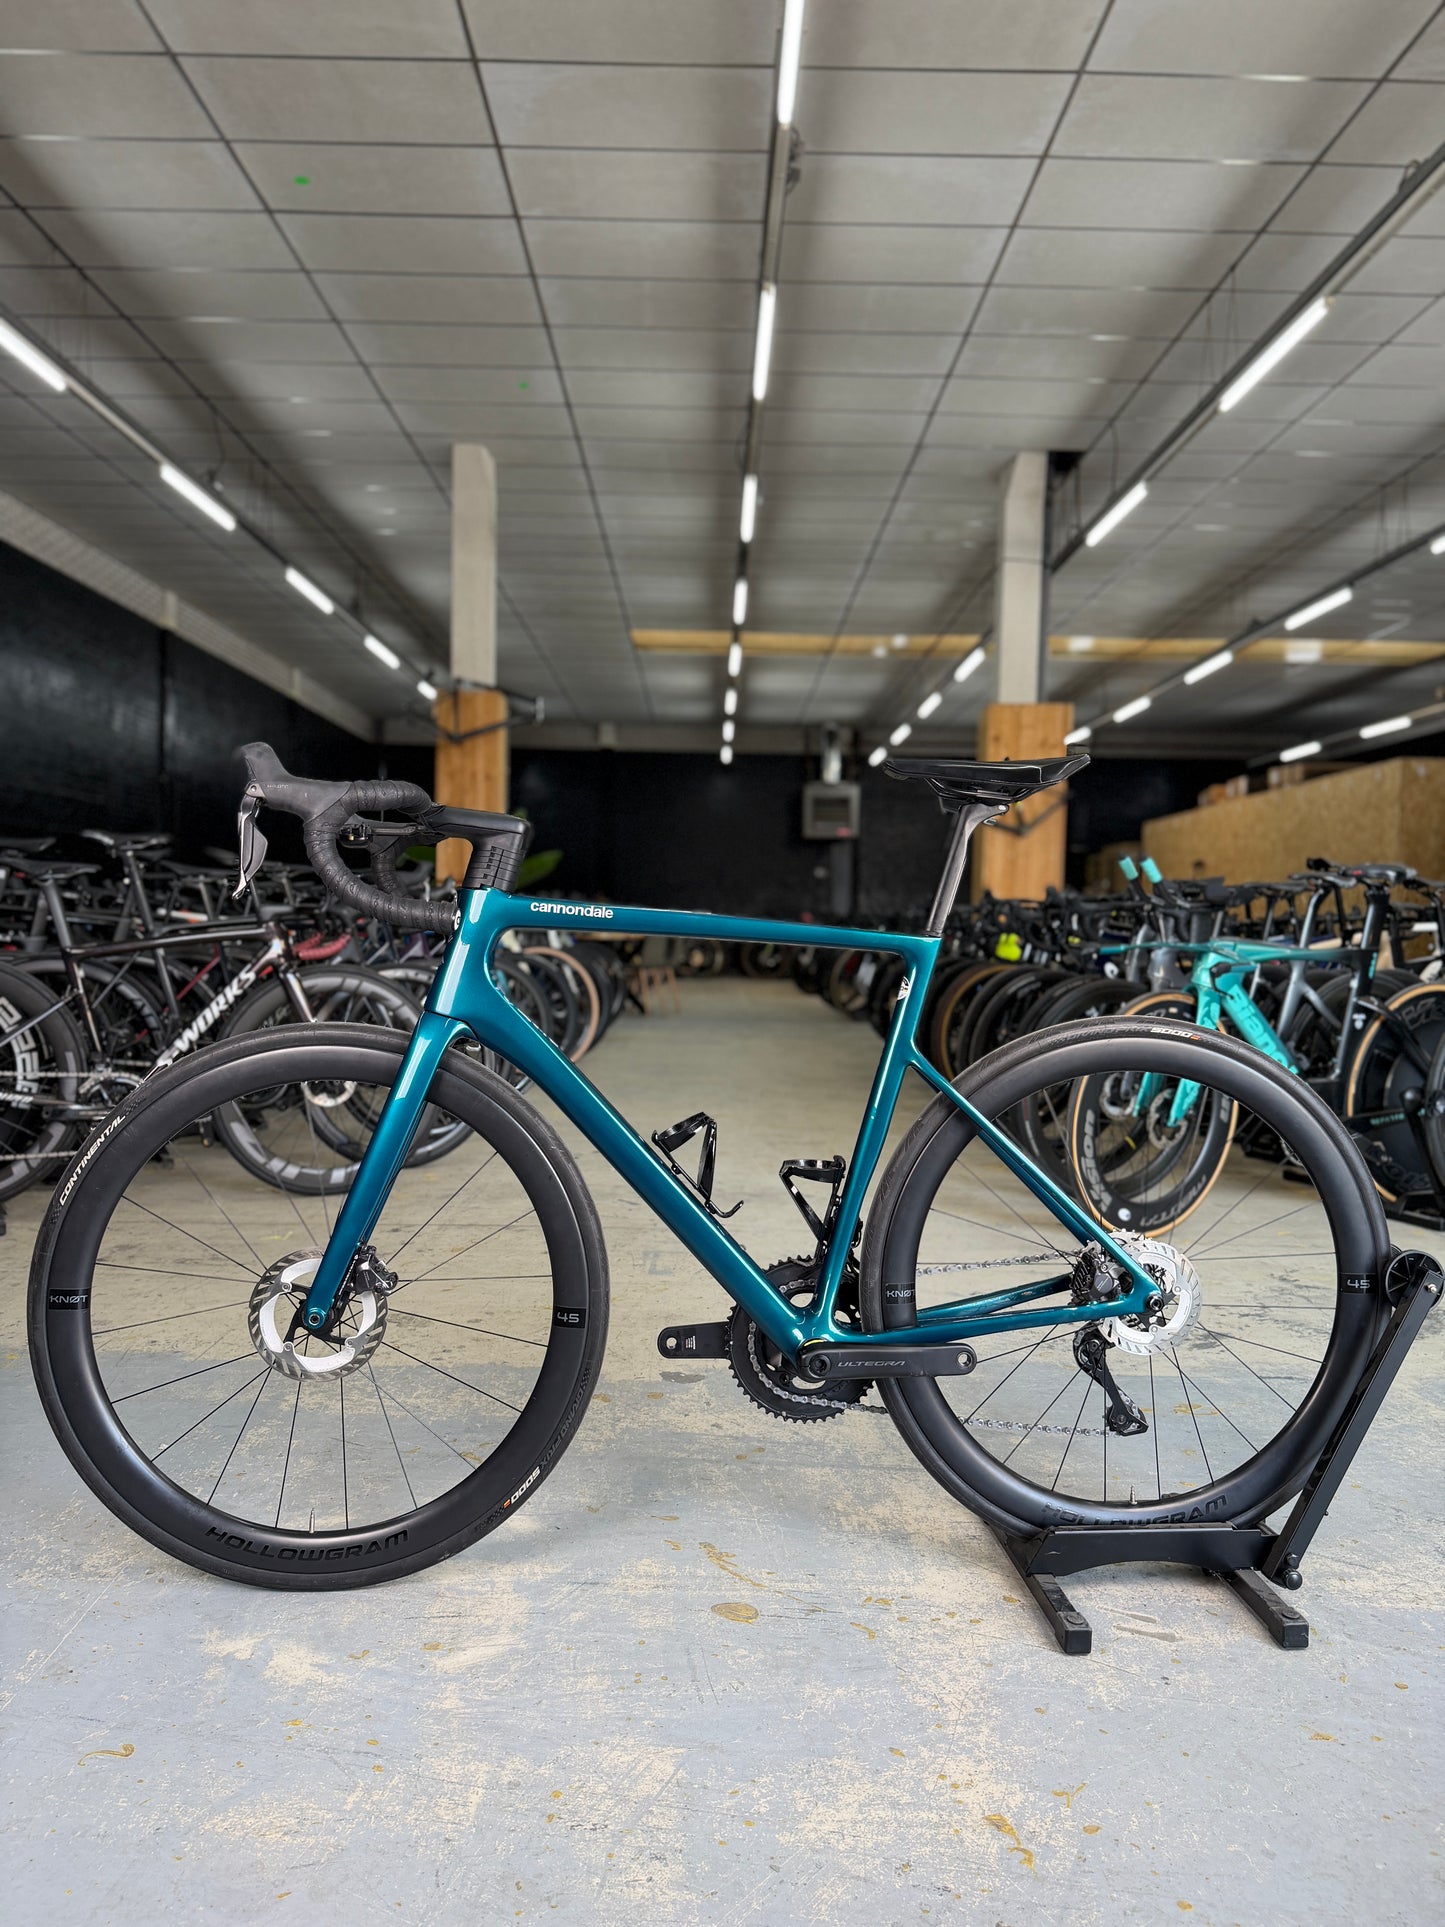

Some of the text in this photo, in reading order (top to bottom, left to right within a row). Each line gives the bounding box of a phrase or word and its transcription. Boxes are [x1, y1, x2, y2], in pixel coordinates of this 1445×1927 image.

[530, 902, 614, 918] cannondale
[1225, 983, 1299, 1074] Bianc
[60, 1115, 126, 1206] CONTINENTAL
[1347, 1279, 1370, 1289] 45
[557, 1312, 580, 1323] 45
[510, 1465, 541, 1504] 5000
[204, 1526, 409, 1562] HOLLOWGRAM
